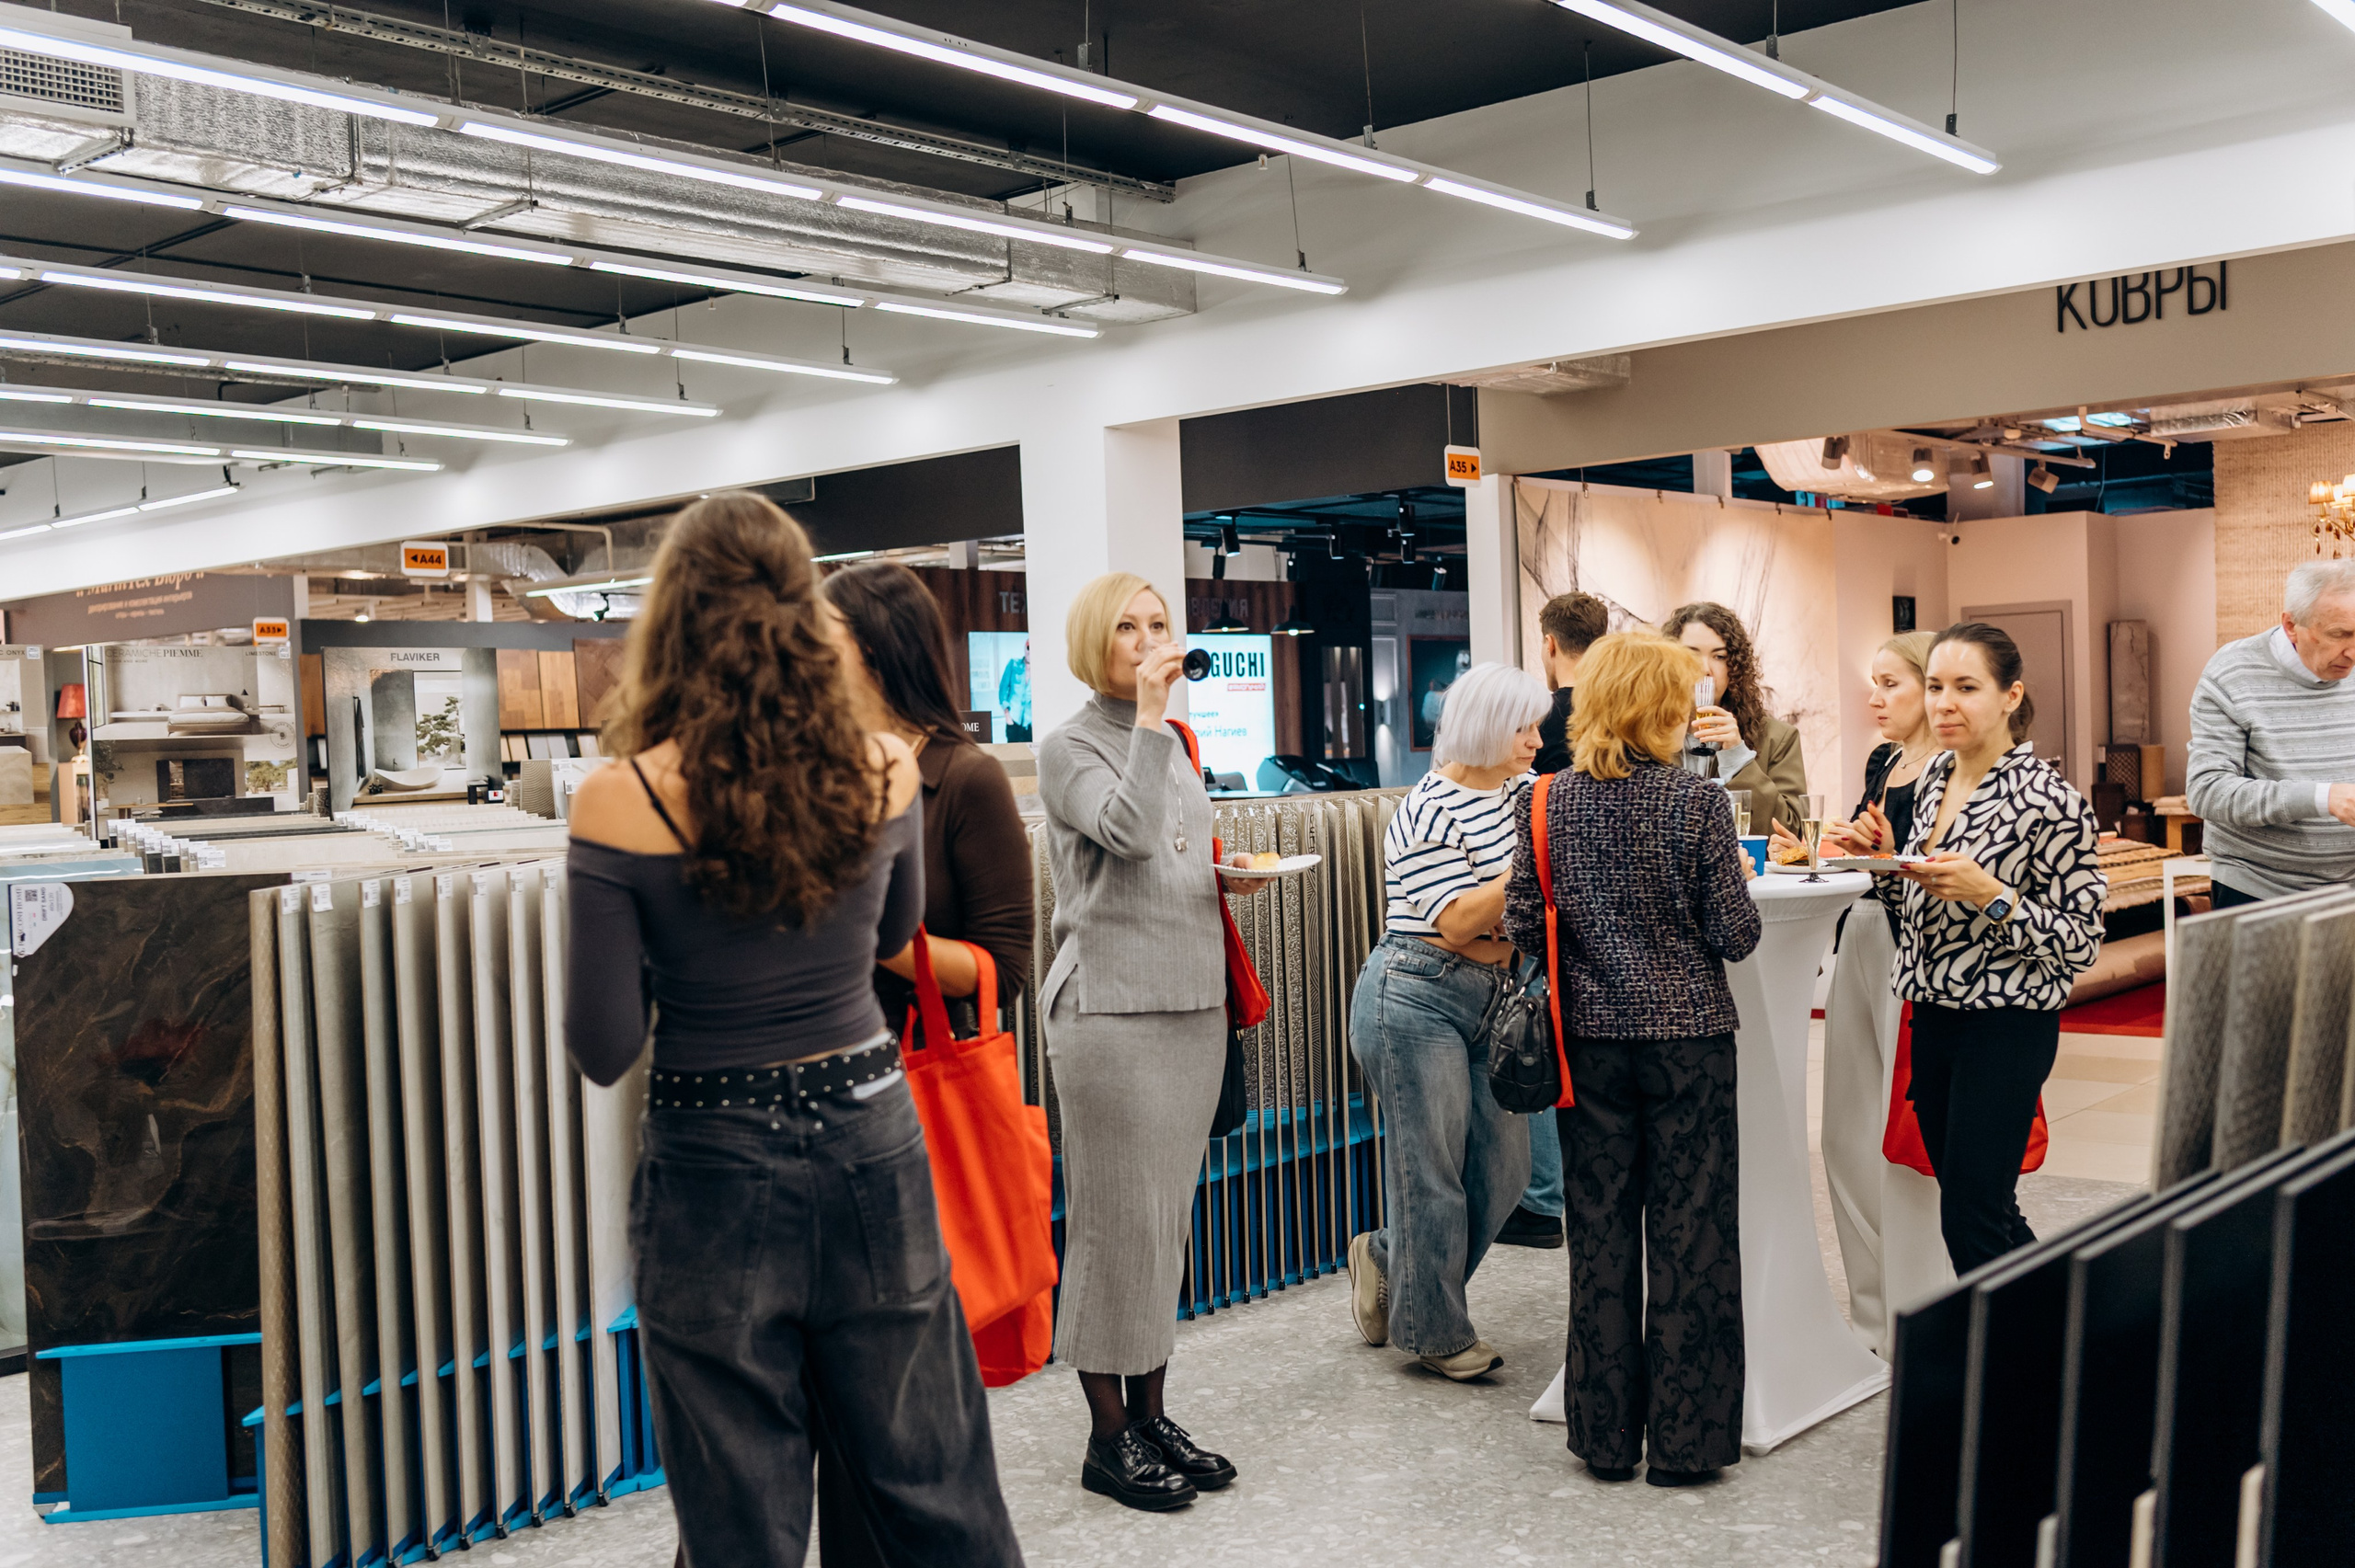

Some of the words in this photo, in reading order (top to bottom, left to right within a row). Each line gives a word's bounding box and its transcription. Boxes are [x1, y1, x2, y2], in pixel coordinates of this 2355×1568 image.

[1450, 459, 1467, 474] A35
[419, 554, 442, 565] A44
[105, 648, 162, 658] CERAMICHE
[163, 648, 203, 658] PIEMME
[390, 652, 440, 661] FLAVIKER
[1210, 652, 1265, 678] GUCHI
